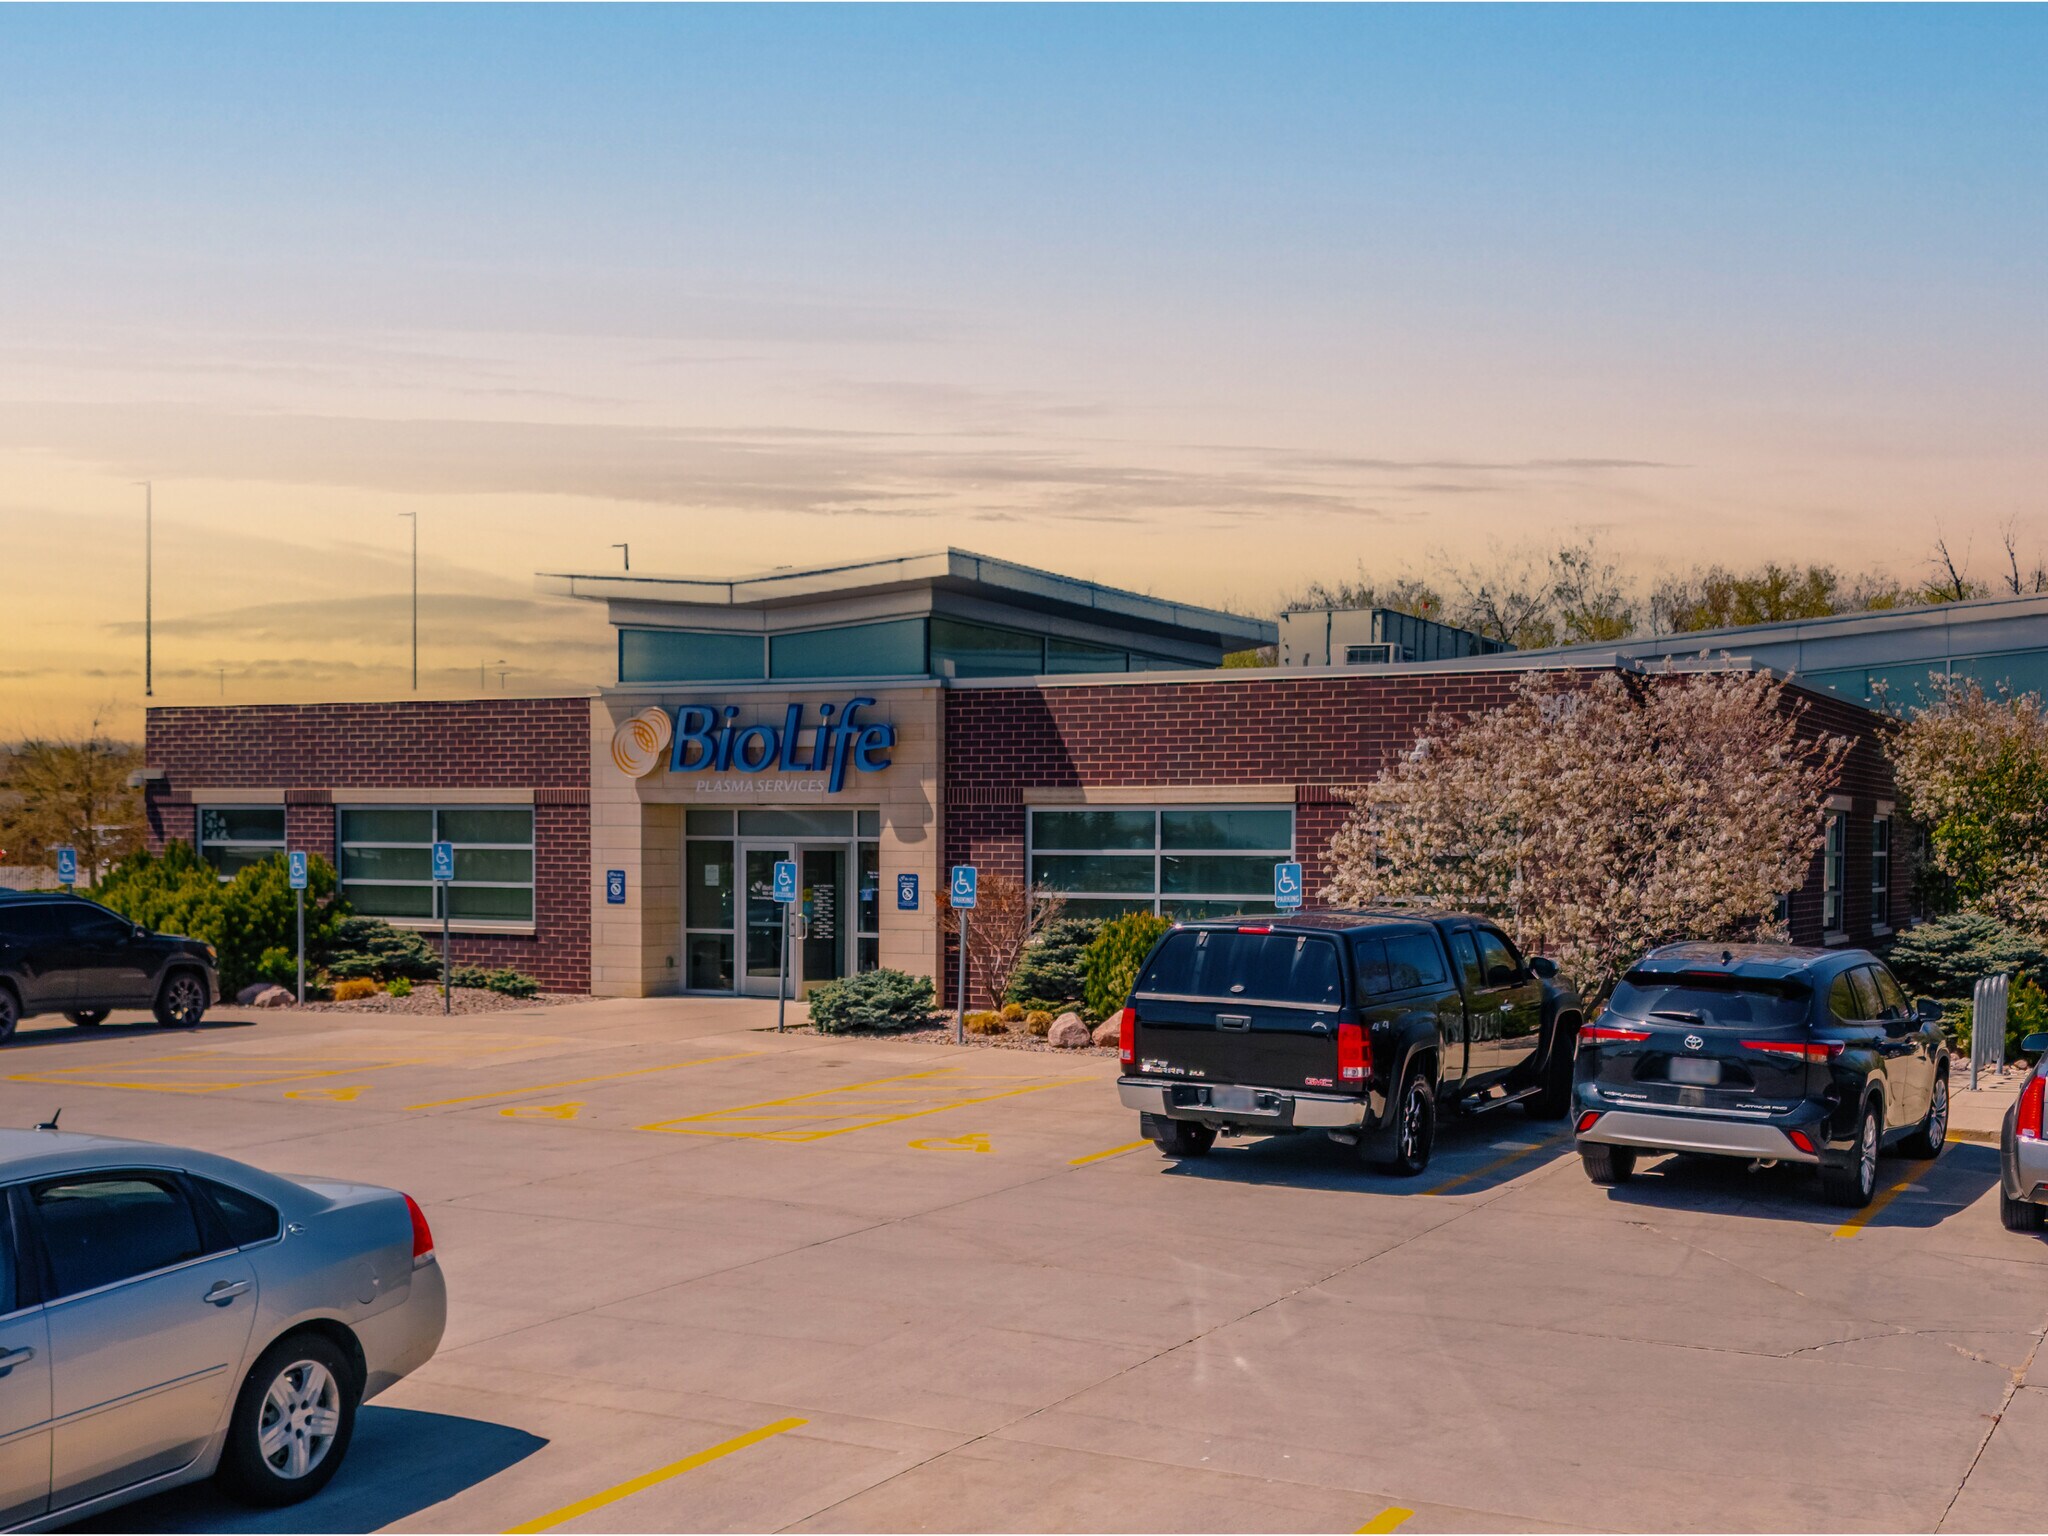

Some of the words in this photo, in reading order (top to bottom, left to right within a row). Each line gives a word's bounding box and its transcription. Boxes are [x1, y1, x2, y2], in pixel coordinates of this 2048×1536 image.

[669, 697, 895, 793] BioLife
[695, 780, 754, 793] PLASMA
[756, 780, 825, 793] SERVICES
[1277, 895, 1300, 903] PARKING
[1304, 1076, 1333, 1087] GMC
[1603, 1090, 1648, 1099] HIGHLANDER
